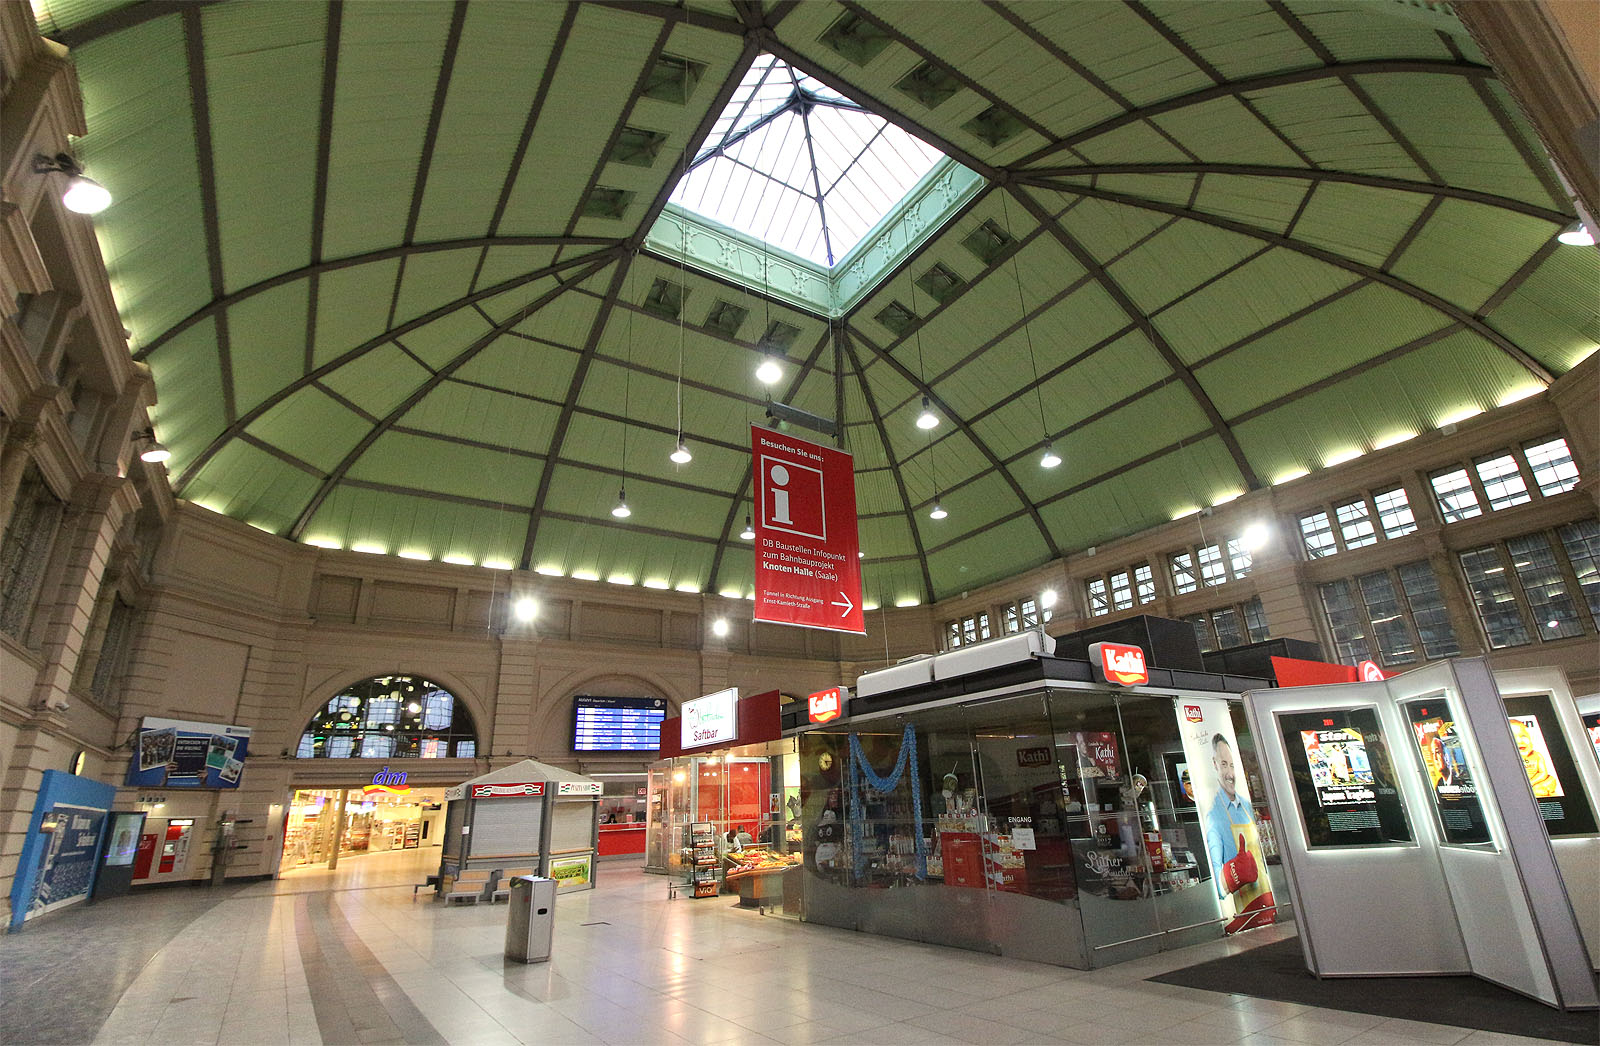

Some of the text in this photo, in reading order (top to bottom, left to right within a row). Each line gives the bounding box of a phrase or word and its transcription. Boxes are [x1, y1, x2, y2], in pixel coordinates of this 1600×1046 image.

[760, 438, 824, 462] Besuchen Sie uns:
[762, 538, 846, 562] DB Baustellen Infopunkt
[762, 551, 835, 570] zum Bahnbauprojekt
[762, 561, 838, 582] Knoten Halle (Saale)
[763, 590, 779, 598] Tunnel
[785, 593, 805, 602] Richtung
[805, 596, 824, 605] Ausgang
[1104, 648, 1145, 674] Kathi
[809, 691, 838, 715] Kathi
[1184, 707, 1201, 718] Kathi
[693, 729, 718, 742] Saftbar
[1018, 749, 1049, 763] Kathi
[1095, 744, 1114, 762] Kathi
[372, 765, 408, 785] dm
[1084, 850, 1123, 874] Luther
[1229, 862, 1241, 885] Kathi
